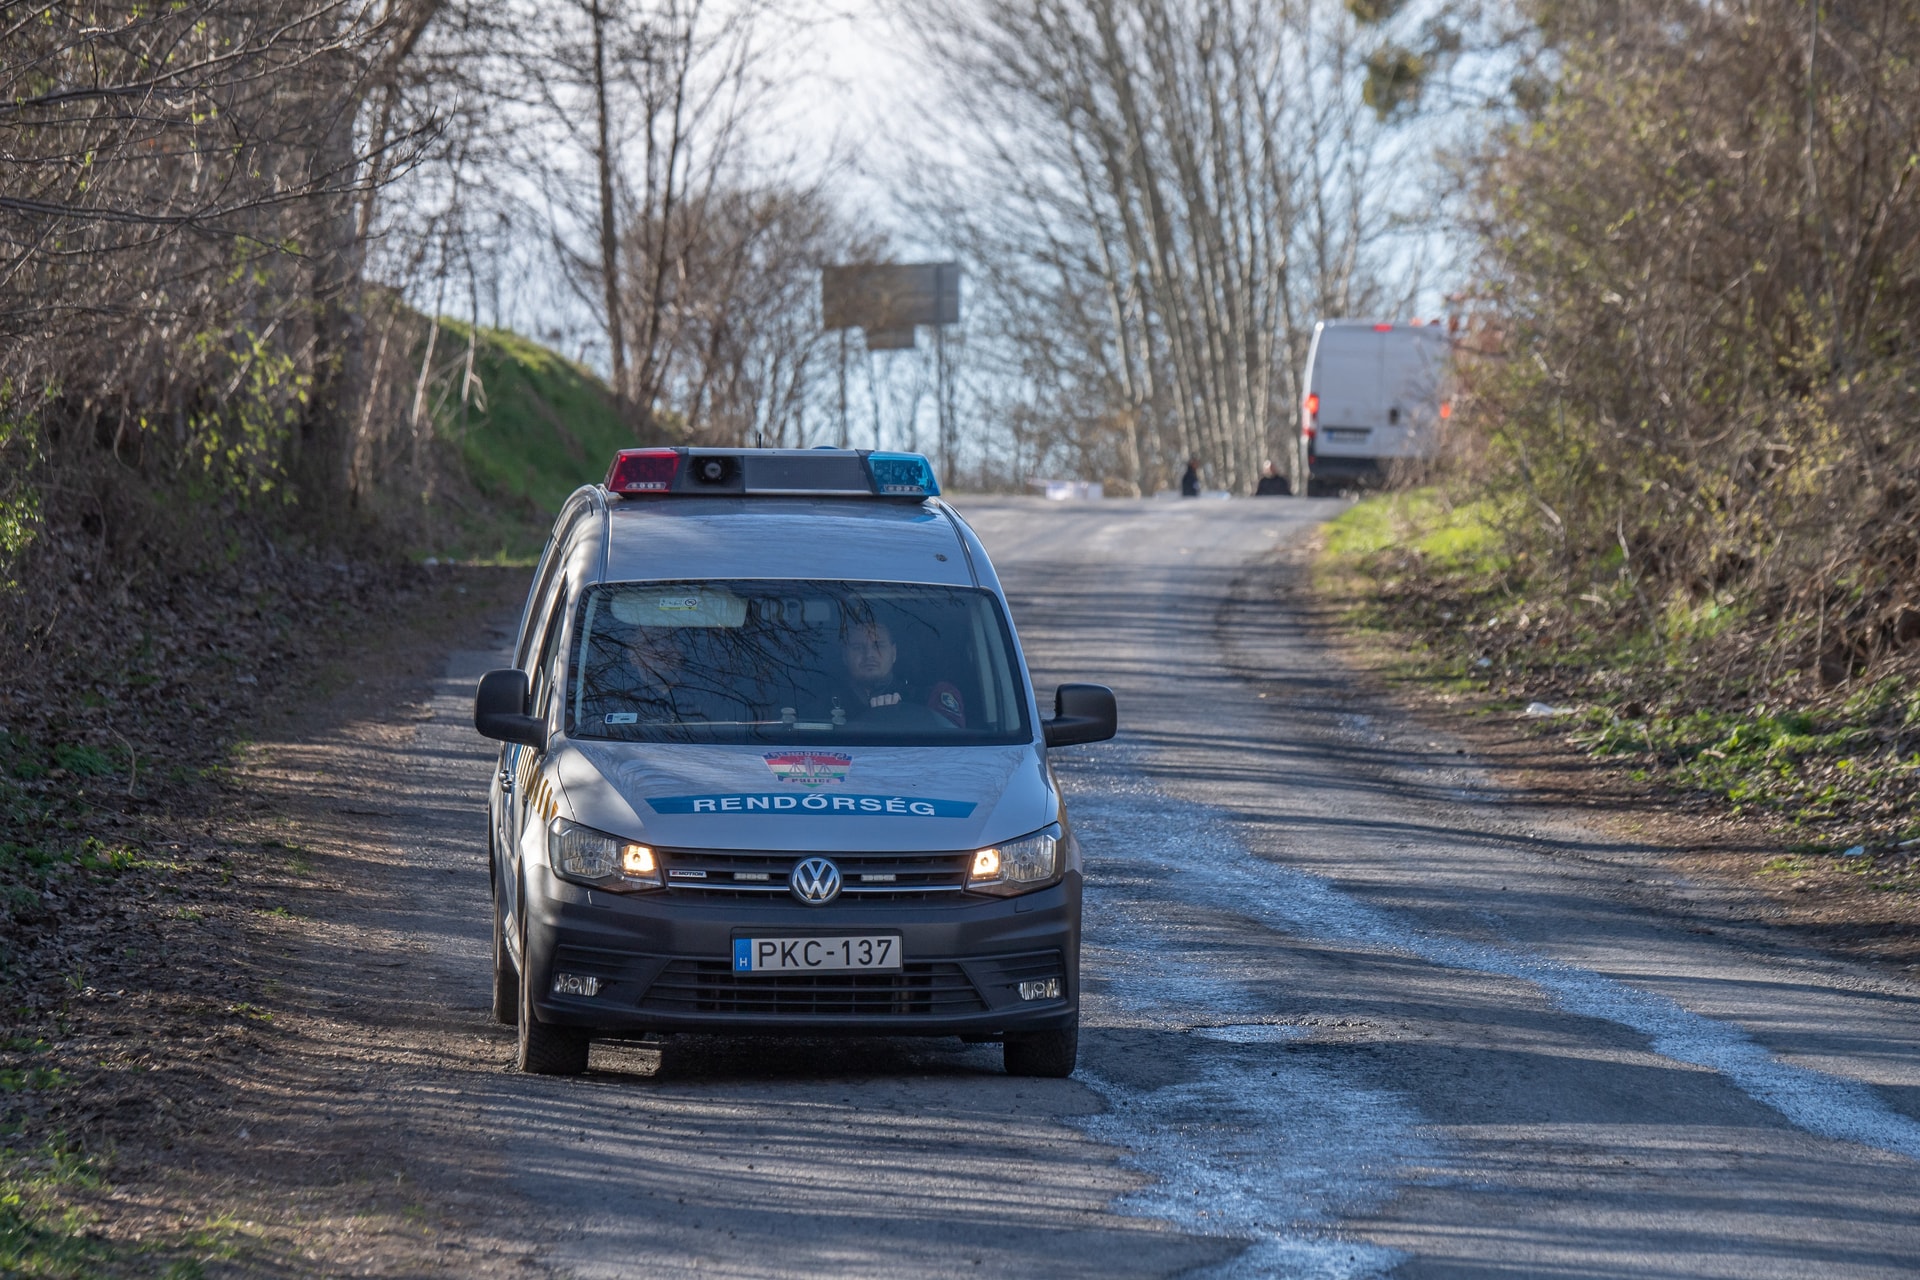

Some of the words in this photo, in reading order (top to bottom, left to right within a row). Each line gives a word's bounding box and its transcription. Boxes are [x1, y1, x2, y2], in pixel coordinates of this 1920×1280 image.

[693, 794, 935, 816] RENDŐRSÉG
[739, 957, 748, 967] H
[758, 940, 892, 967] PKC-137
